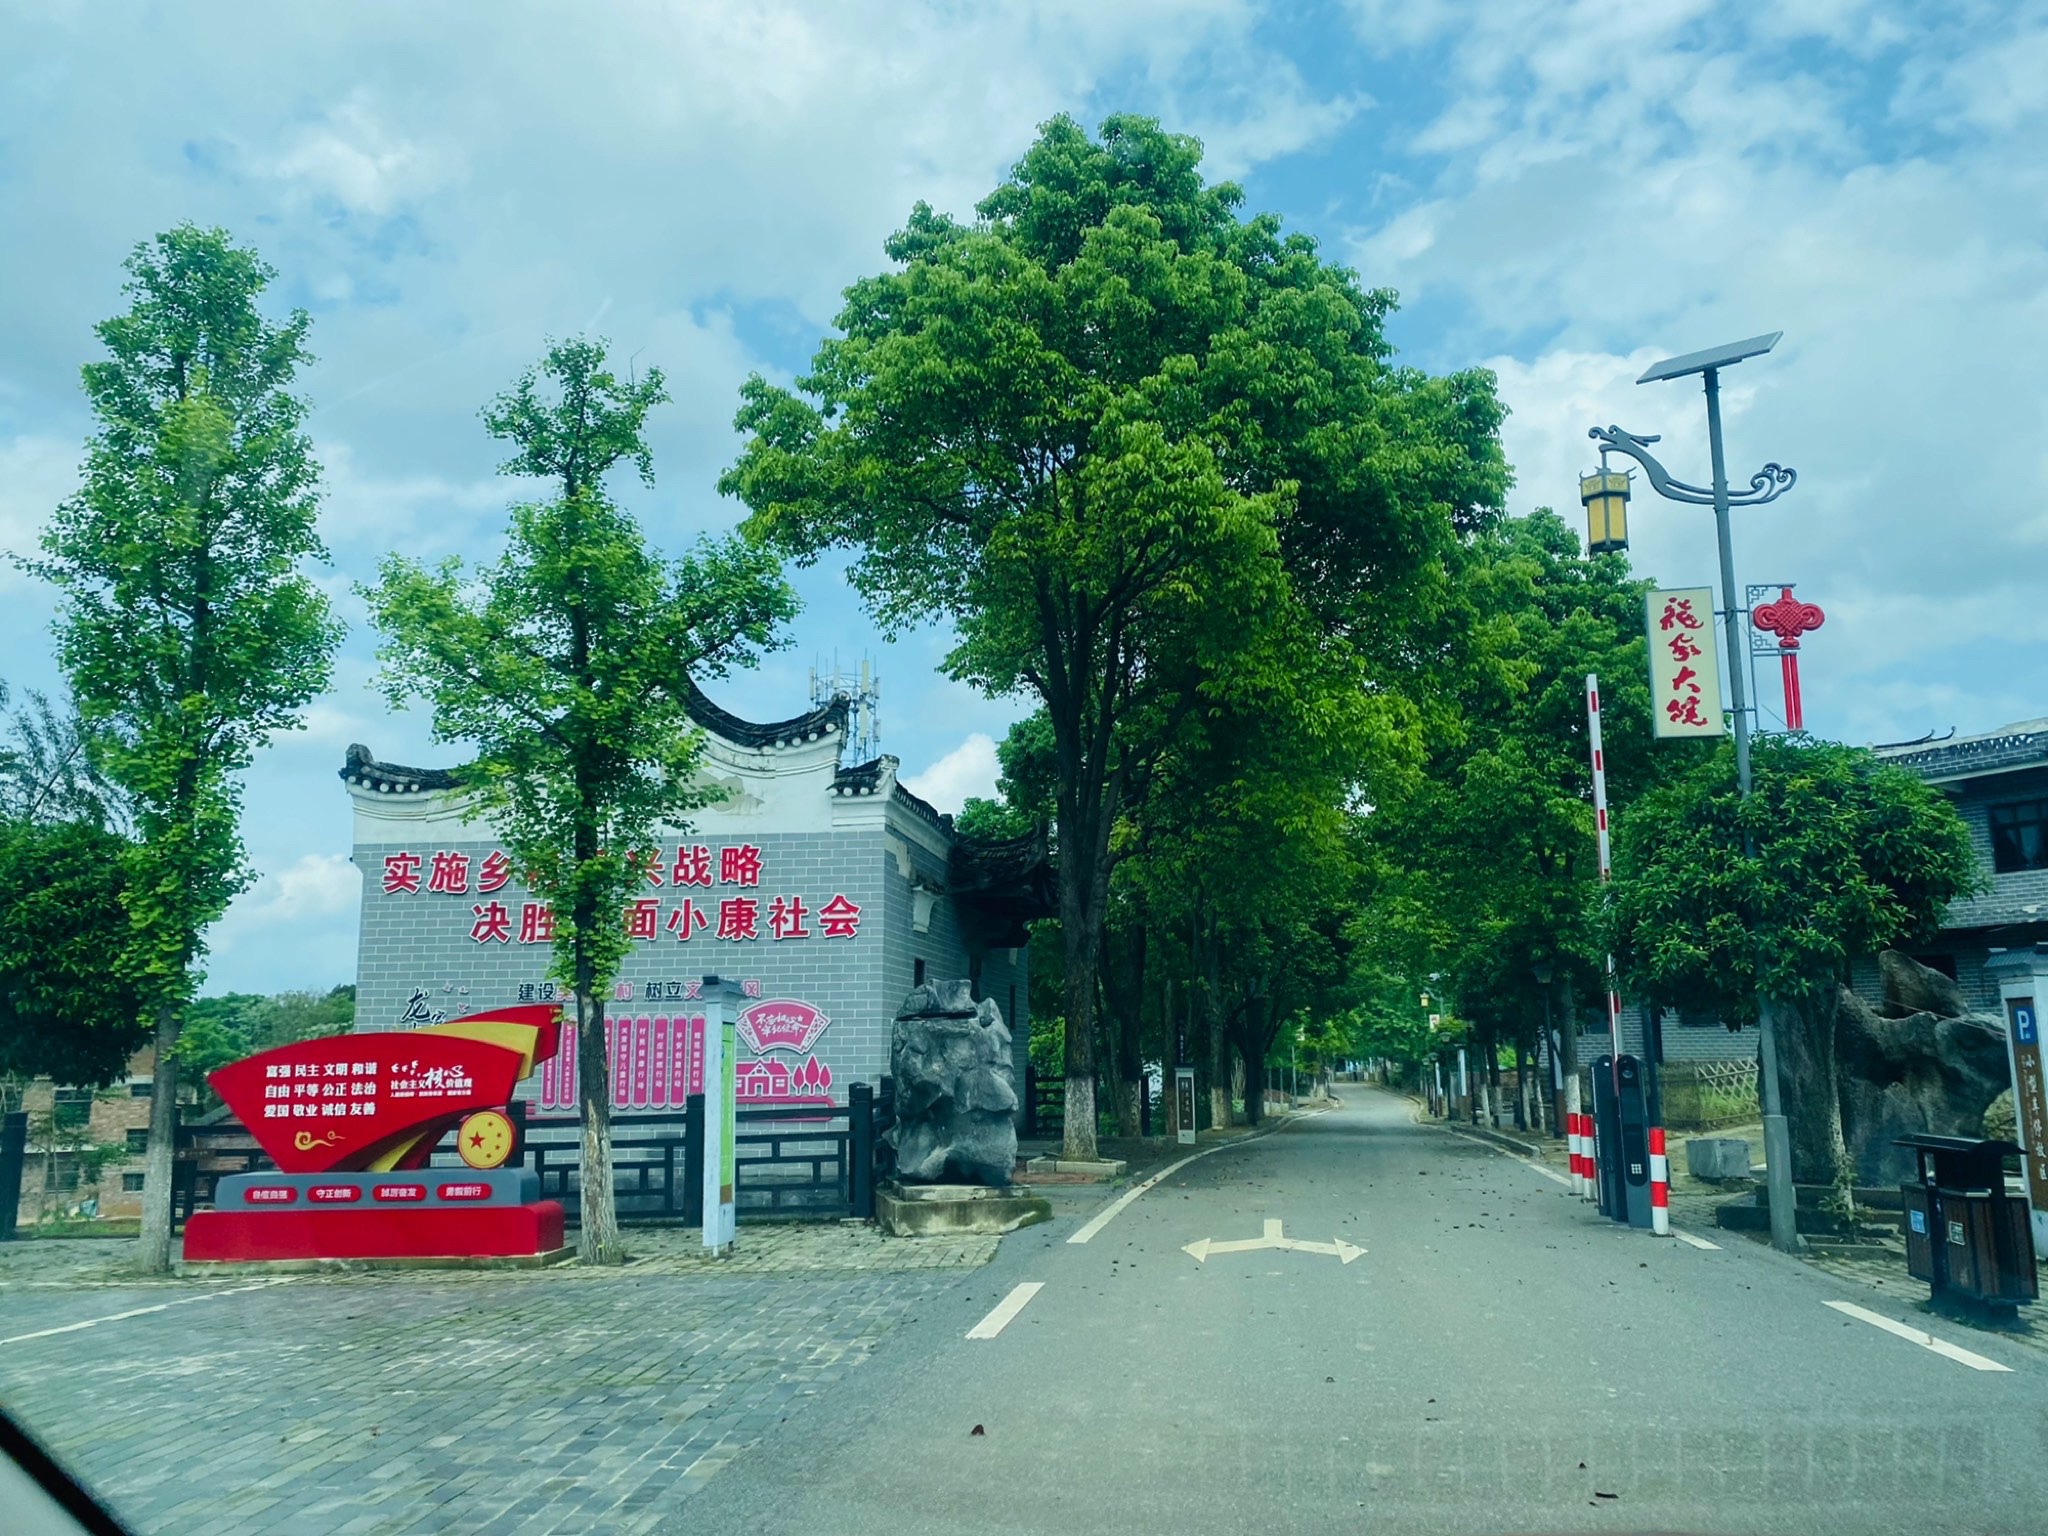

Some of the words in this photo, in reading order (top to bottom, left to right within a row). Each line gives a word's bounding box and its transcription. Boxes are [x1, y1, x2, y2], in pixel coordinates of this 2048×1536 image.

[470, 894, 861, 943] 决胜面小康社会
[645, 979, 761, 1000] 树立文风
[2017, 1010, 2029, 1039] P
[266, 1064, 291, 1078] 富强
[295, 1063, 320, 1077] 民主
[323, 1062, 348, 1076] 文明
[351, 1062, 377, 1075] 和谐
[265, 1085, 290, 1098] 自由
[294, 1083, 319, 1097] 平等
[322, 1082, 347, 1096] 公正
[351, 1081, 376, 1095] 法治
[264, 1104, 289, 1118] 爱国
[293, 1103, 318, 1117] 敬业
[321, 1102, 346, 1116] 诚信
[350, 1102, 375, 1115] 友善
